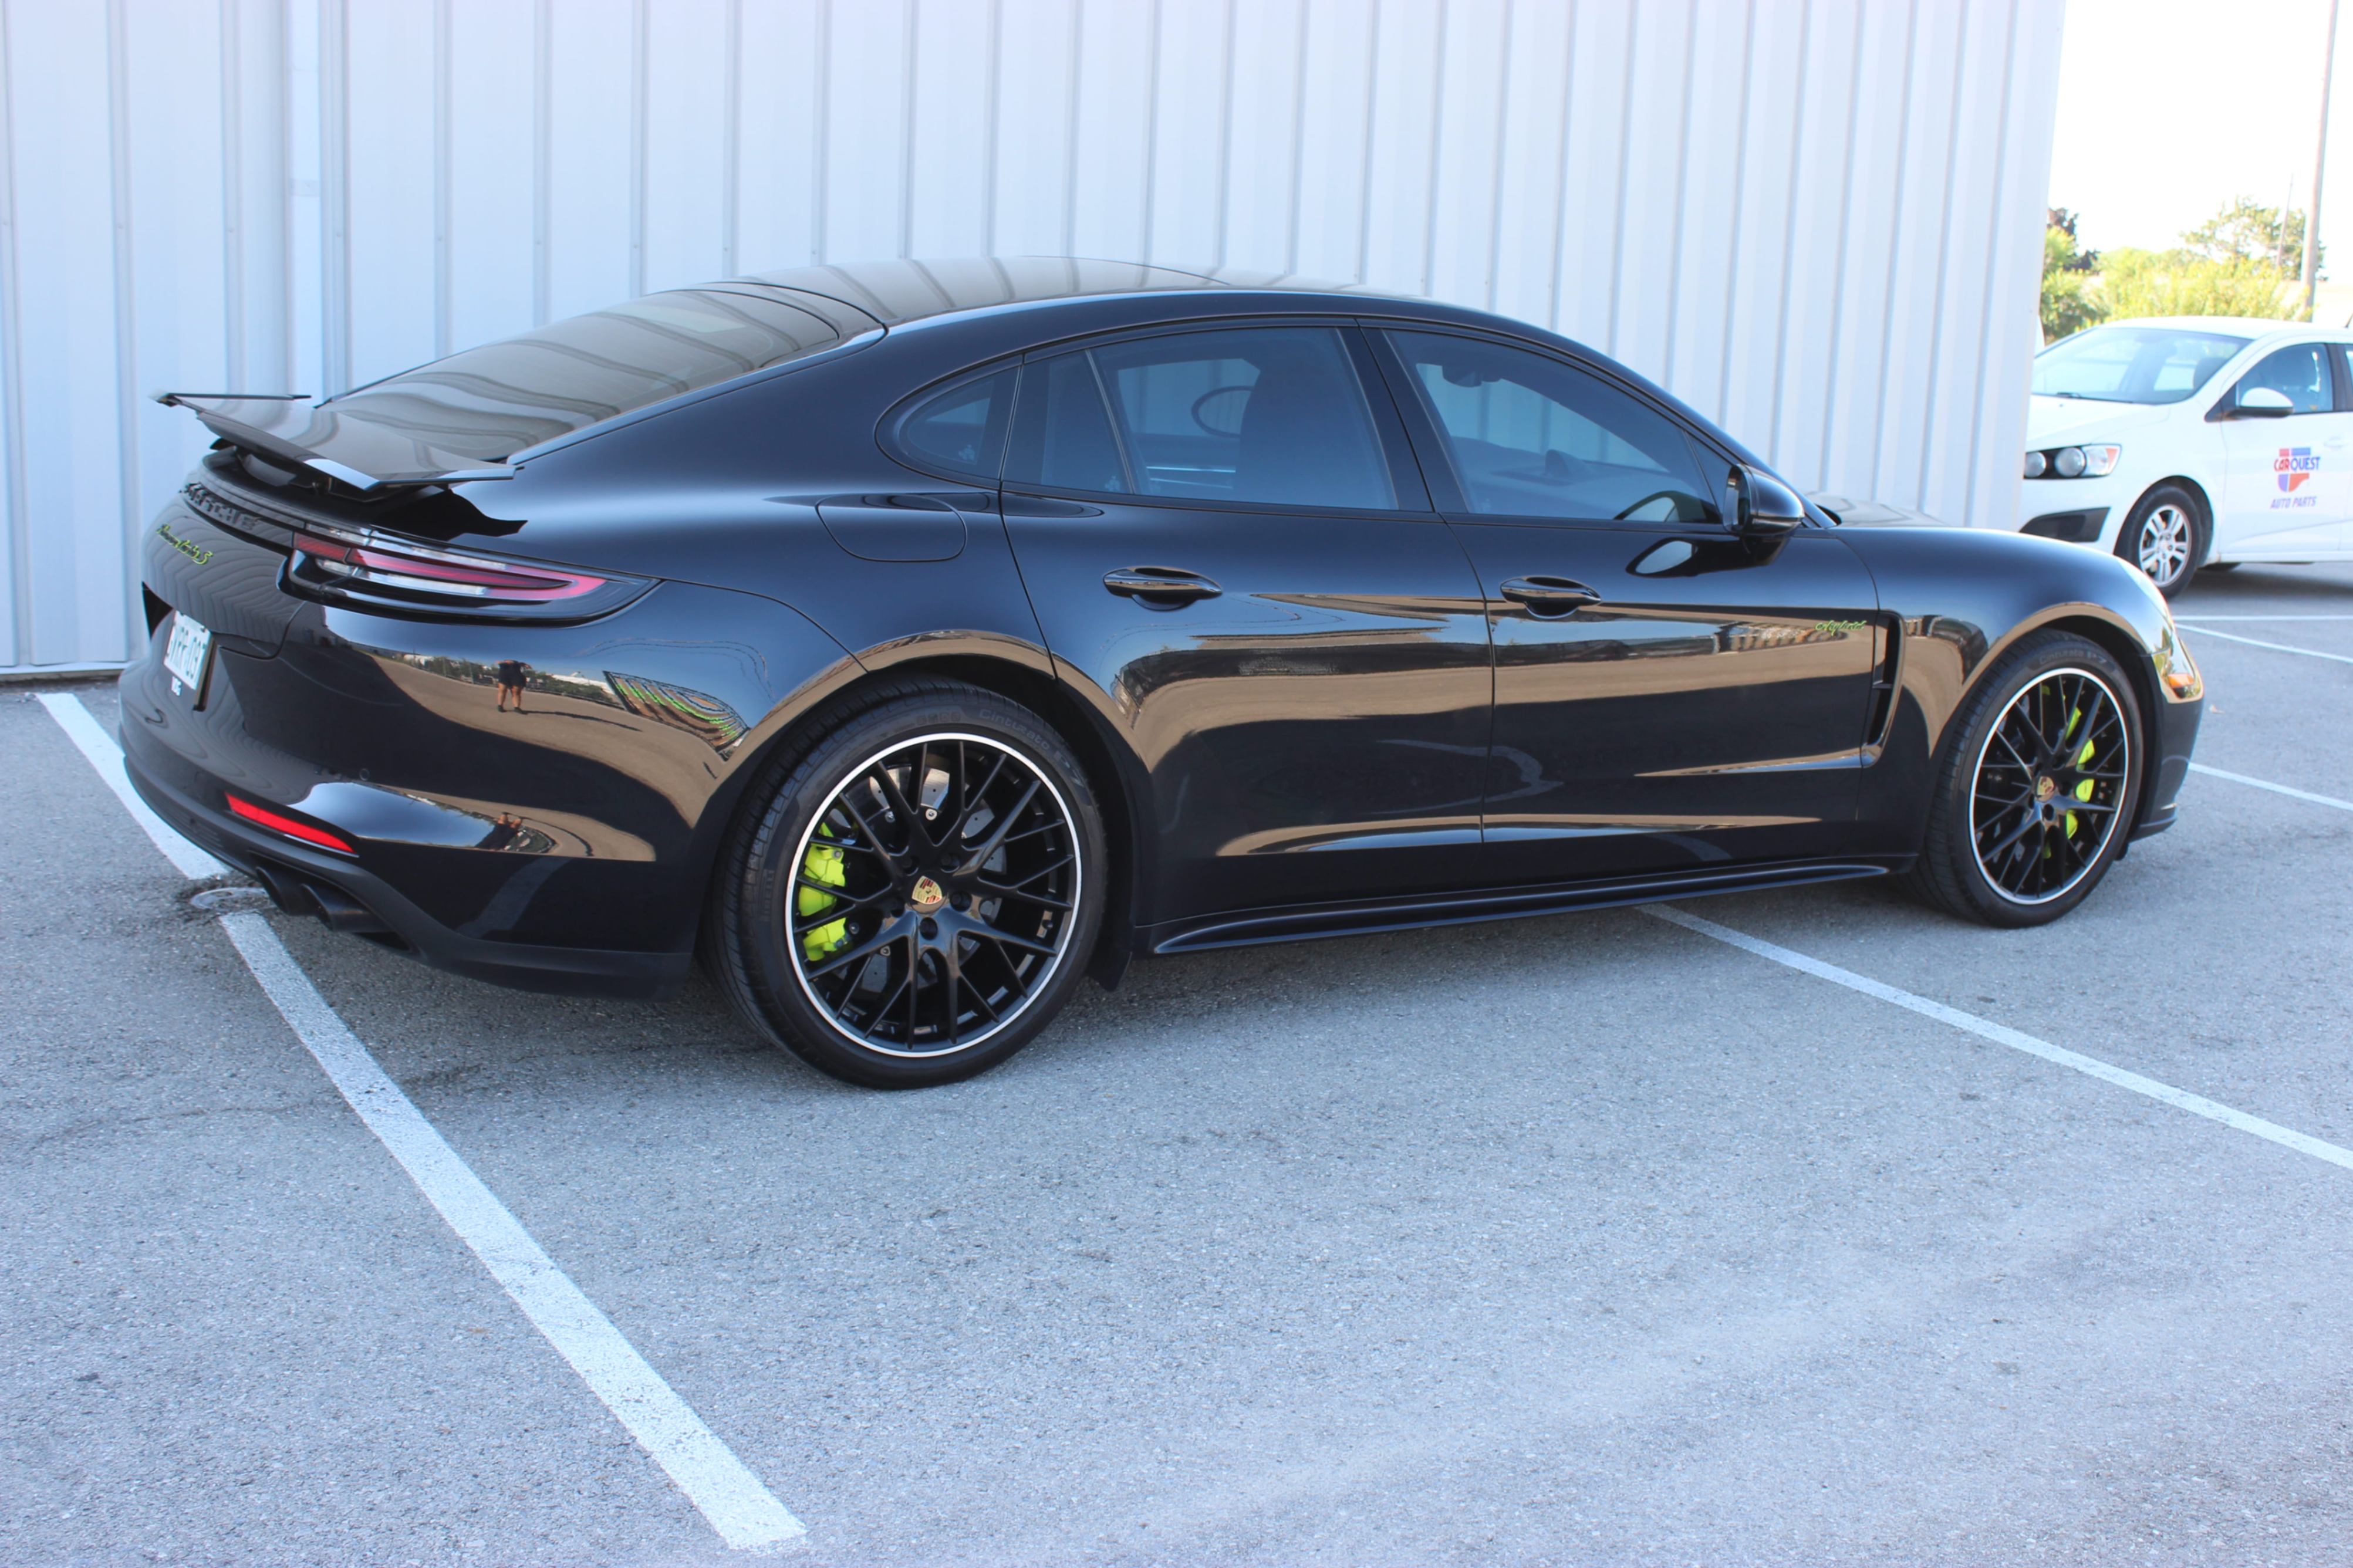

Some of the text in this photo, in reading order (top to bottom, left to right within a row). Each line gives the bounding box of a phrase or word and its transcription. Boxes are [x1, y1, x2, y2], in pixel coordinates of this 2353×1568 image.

[2270, 496, 2317, 509] AUTO PARTS
[979, 708, 1051, 751] Cinturato
